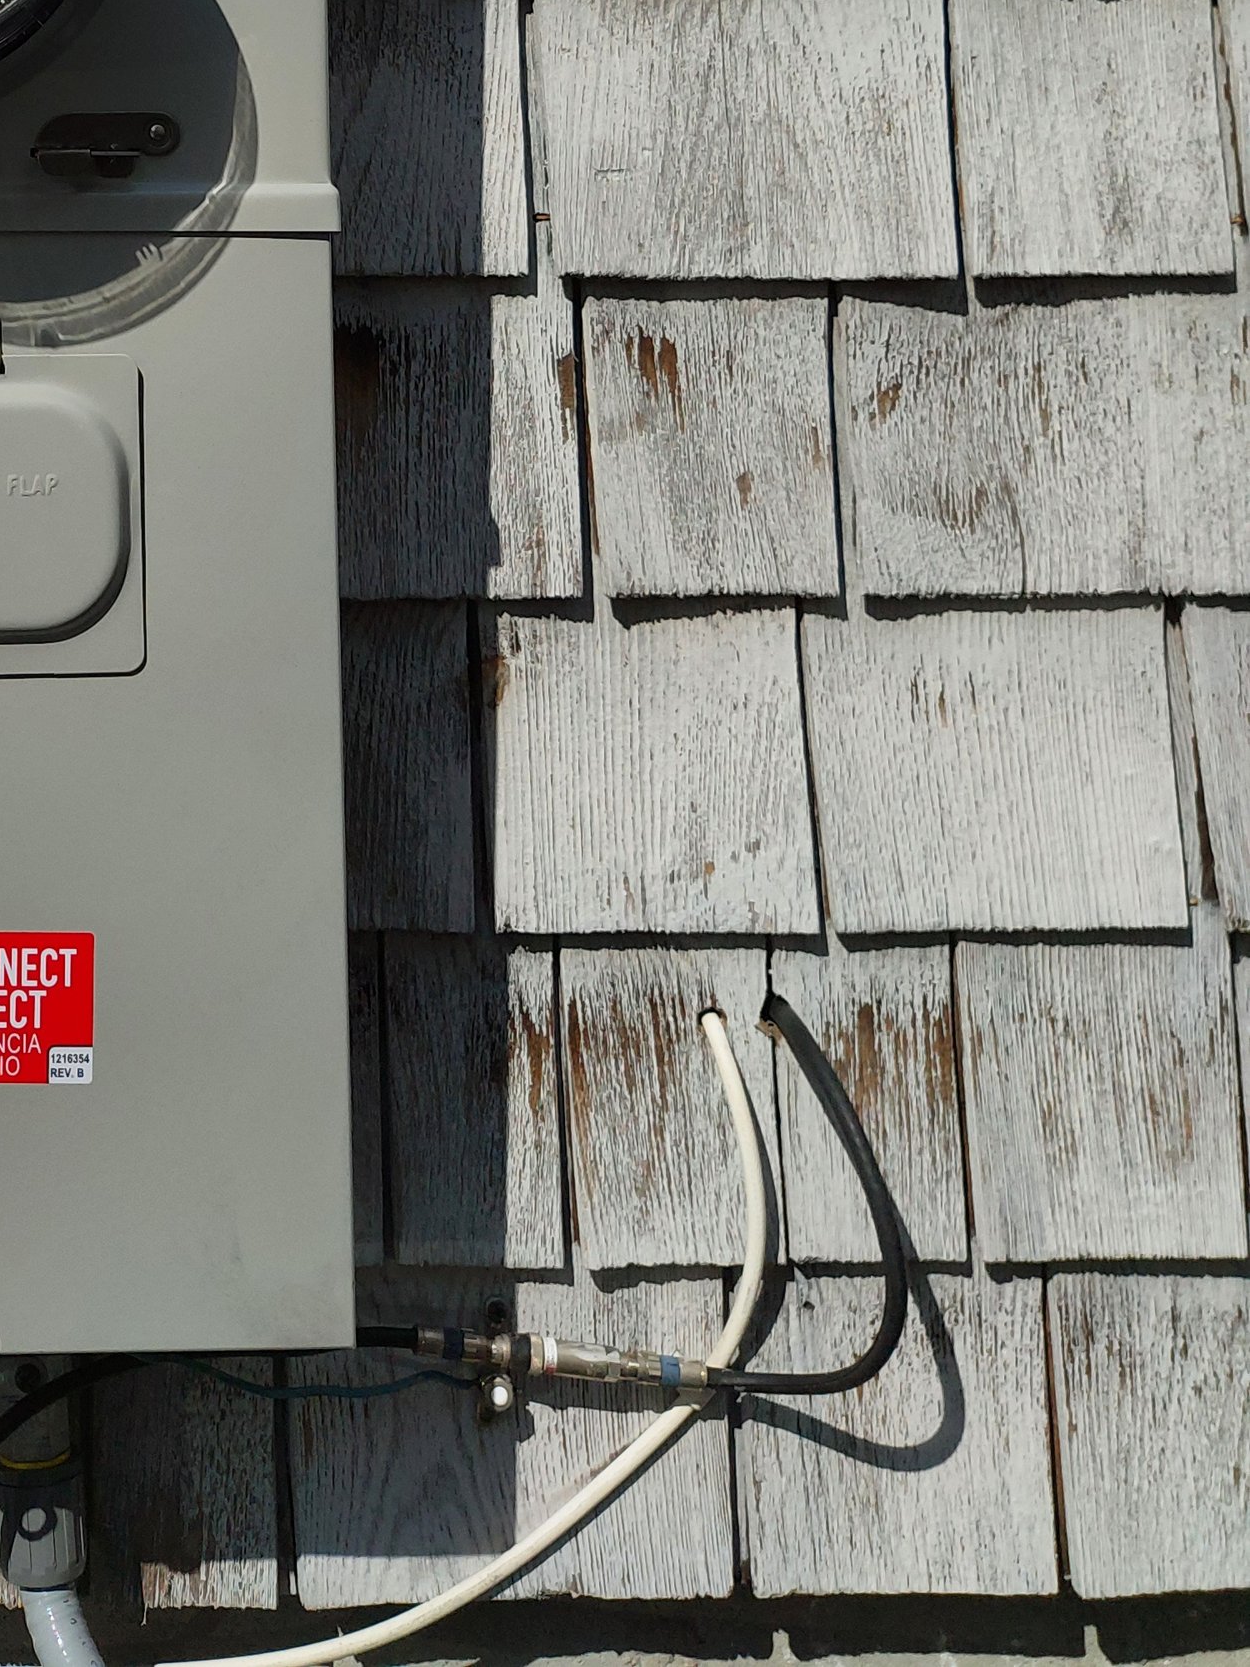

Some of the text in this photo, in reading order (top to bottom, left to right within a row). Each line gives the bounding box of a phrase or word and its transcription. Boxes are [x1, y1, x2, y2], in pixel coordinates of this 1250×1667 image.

[5, 473, 60, 498] FLAP
[51, 1053, 90, 1064] 1216354
[50, 1067, 84, 1078] REV. B
